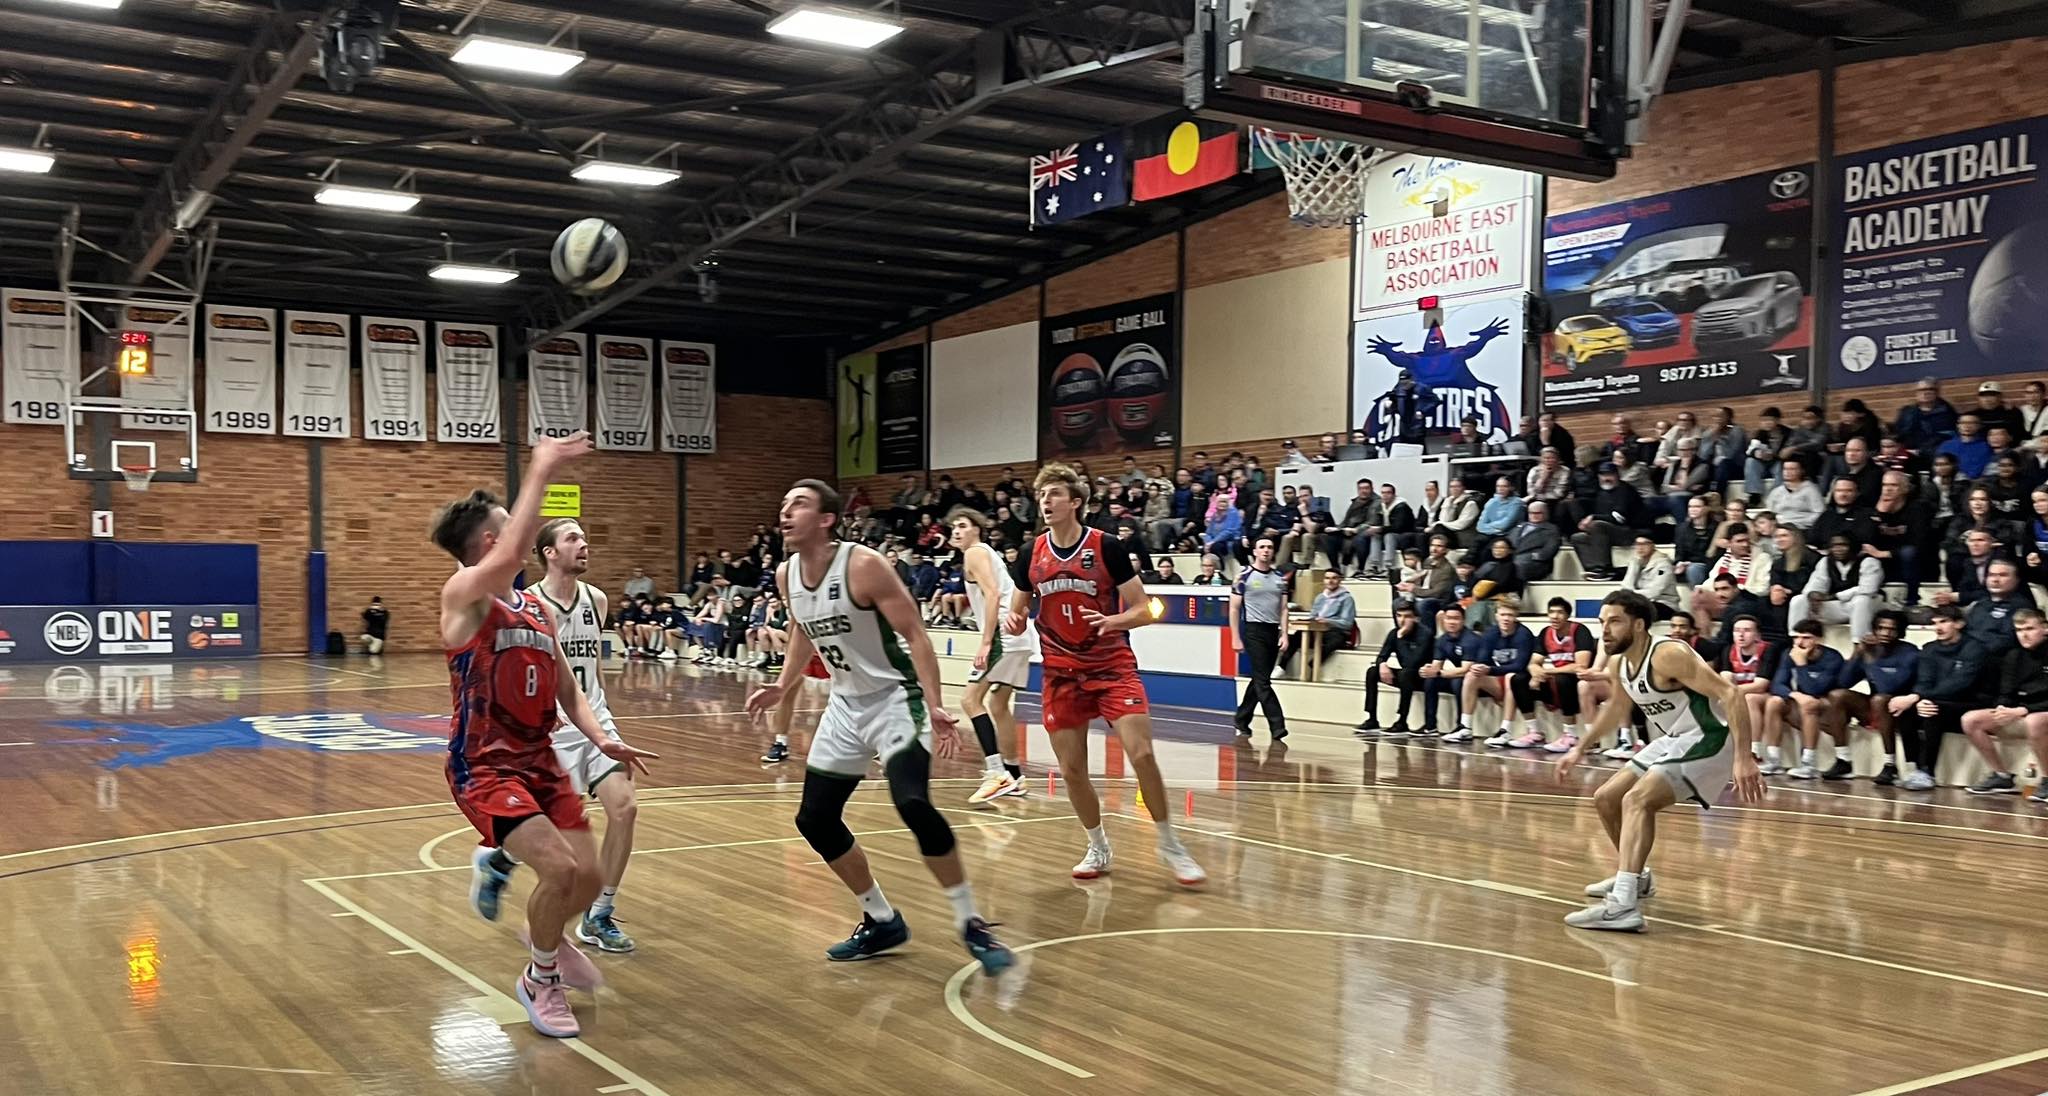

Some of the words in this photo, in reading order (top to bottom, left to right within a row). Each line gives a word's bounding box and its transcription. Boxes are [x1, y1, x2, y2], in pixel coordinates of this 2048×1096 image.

[1392, 163, 1421, 192] The
[1424, 157, 1462, 179] hom
[1844, 134, 2037, 203] BASKETBALL
[1370, 214, 1461, 250] MELBOURNE
[1471, 203, 1519, 229] EAST
[1843, 194, 1990, 254] ACADEMY
[1386, 233, 1495, 270] BASKETBALL
[1384, 255, 1499, 295] ASSOCIATION
[1115, 314, 1142, 333] GAME
[1142, 309, 1166, 328] BALL
[120, 349, 148, 374] 12
[1659, 365, 1697, 383] 9877
[1698, 361, 1738, 379] 3133
[11, 400, 66, 420] 198
[211, 410, 271, 431] 1989
[1378, 386, 1492, 443] STRES
[288, 414, 345, 434] 1991
[370, 419, 422, 437] 1991
[443, 421, 497, 439] 1992
[602, 430, 648, 447] 1997
[665, 433, 713, 450] 1998
[97, 514, 109, 534] 1
[97, 610, 173, 641] ONE
[1061, 603, 1075, 625] 4
[56, 625, 81, 641] NBL
[525, 665, 538, 697] 8
